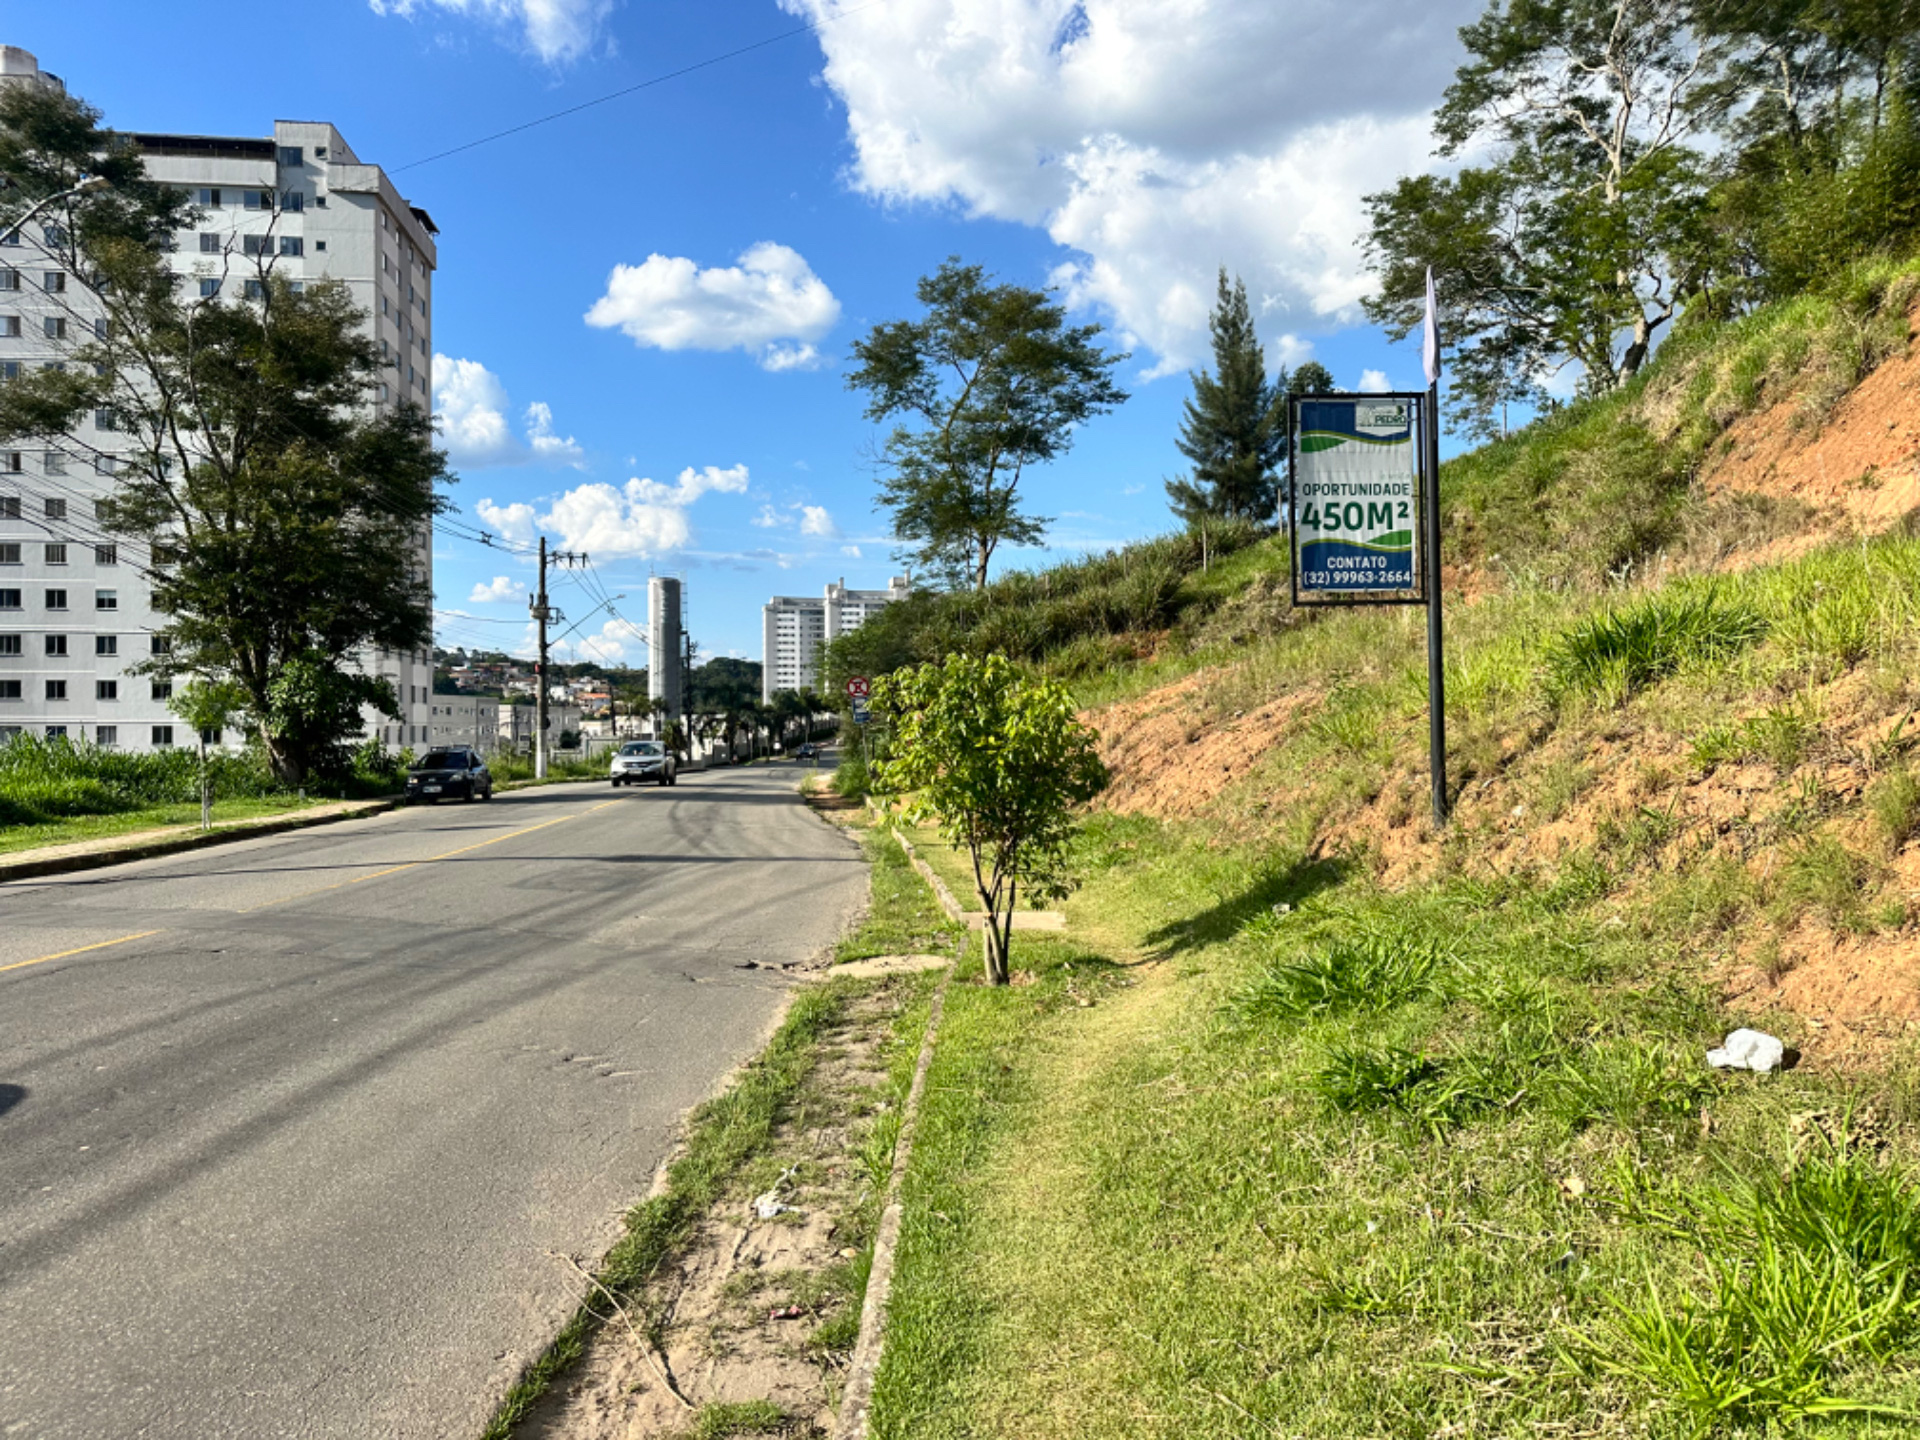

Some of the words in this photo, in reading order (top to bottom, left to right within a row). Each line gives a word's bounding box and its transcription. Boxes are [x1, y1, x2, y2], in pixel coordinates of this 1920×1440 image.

[1302, 483, 1410, 496] OPORTUNIDADE
[1326, 556, 1387, 569] CONTATO
[1303, 571, 1330, 585] (32)
[1332, 570, 1411, 584] 99963-2664
